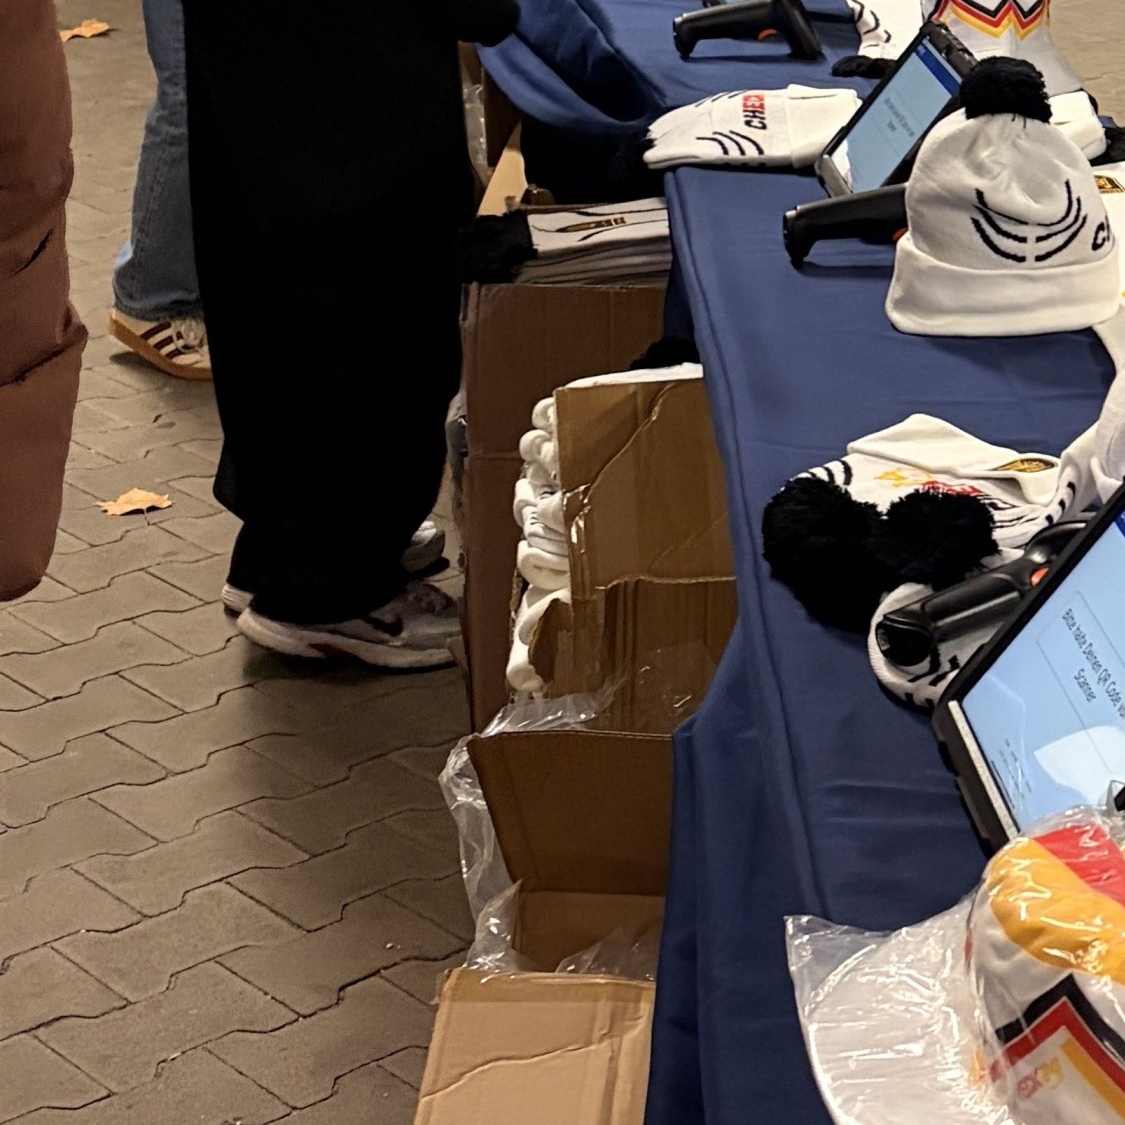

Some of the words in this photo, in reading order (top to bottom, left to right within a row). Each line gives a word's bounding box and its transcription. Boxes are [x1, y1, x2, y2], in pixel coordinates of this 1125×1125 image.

[1072, 624, 1087, 649] halte
[1083, 642, 1103, 674] Deinen
[1096, 668, 1112, 687] QR
[1105, 681, 1122, 707] Code
[1074, 668, 1096, 703] Scanner
